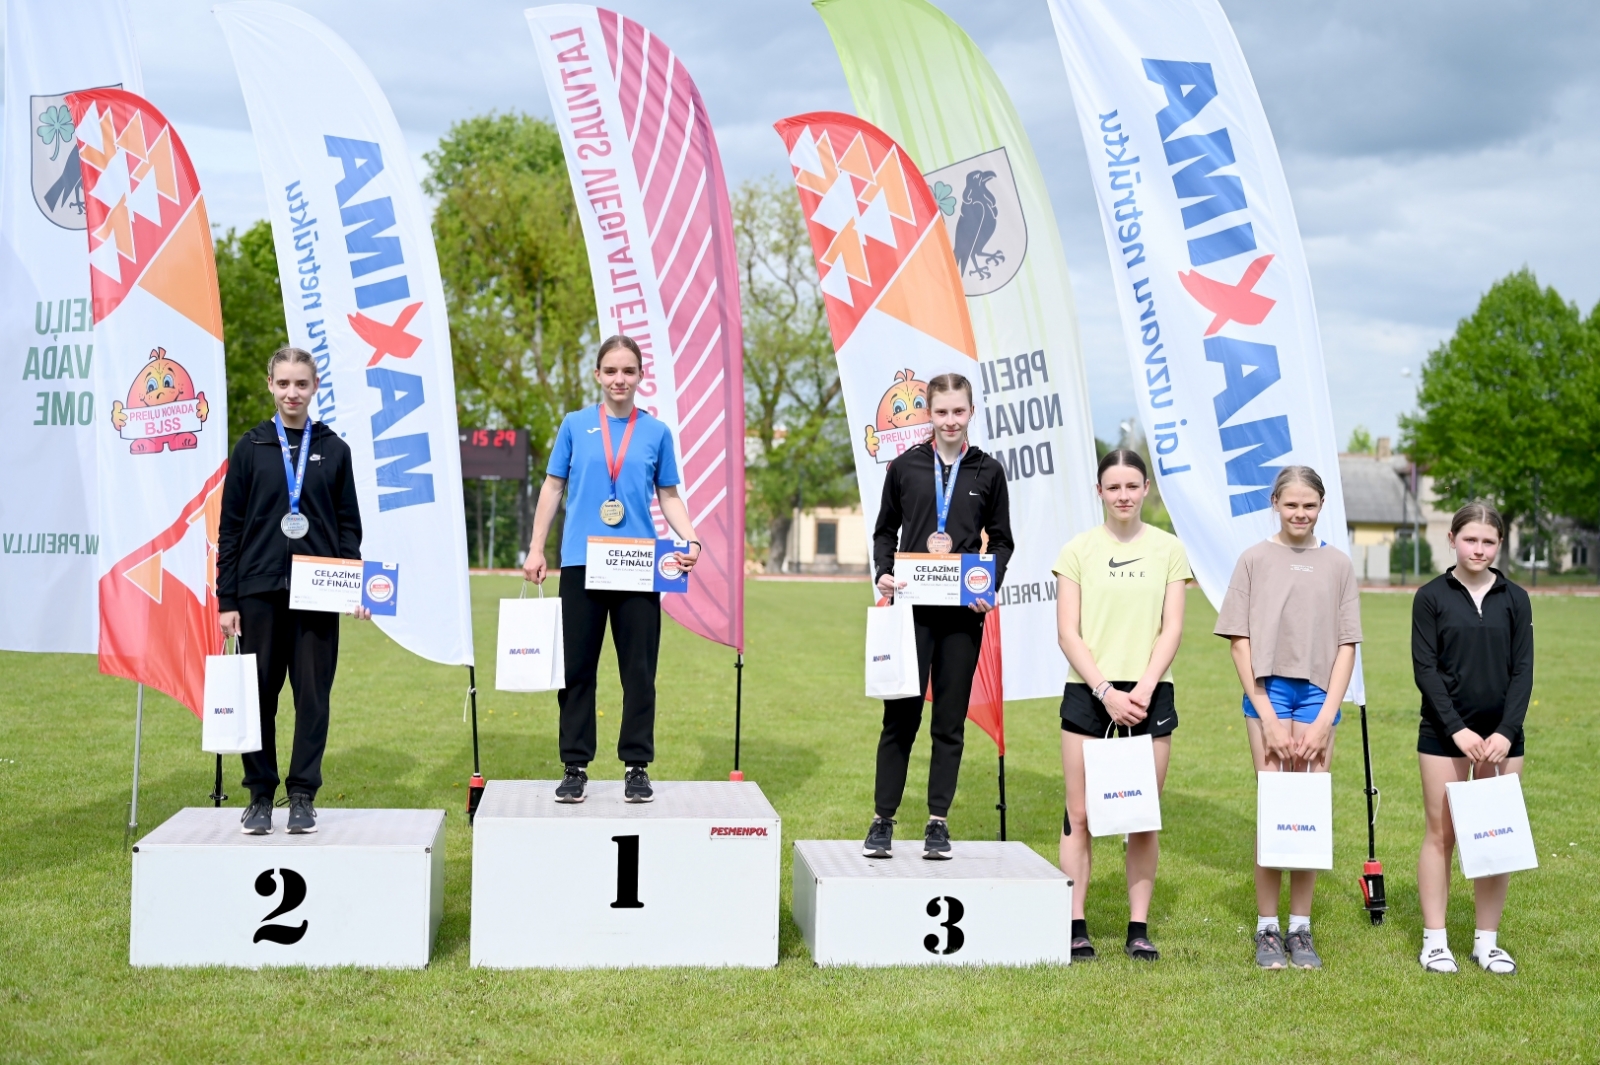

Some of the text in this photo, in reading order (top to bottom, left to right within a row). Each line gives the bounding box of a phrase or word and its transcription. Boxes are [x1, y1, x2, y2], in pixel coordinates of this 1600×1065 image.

[129, 403, 194, 421] PREIĻU NOVADA
[145, 417, 182, 436] BJSS
[880, 430, 912, 444] PREIĻU
[620, 558, 653, 567] FINĀLU
[311, 578, 325, 586] UZ
[326, 578, 361, 589] FINĀLU
[927, 573, 960, 582] FINĀLU
[1103, 789, 1143, 800] MAXIMA
[710, 826, 769, 837] PESMENPOL
[1276, 823, 1317, 832] MAXIMA
[1473, 826, 1514, 840] MAXIMA
[610, 835, 645, 909] 1
[253, 868, 309, 945] 2
[923, 896, 965, 955] 3
